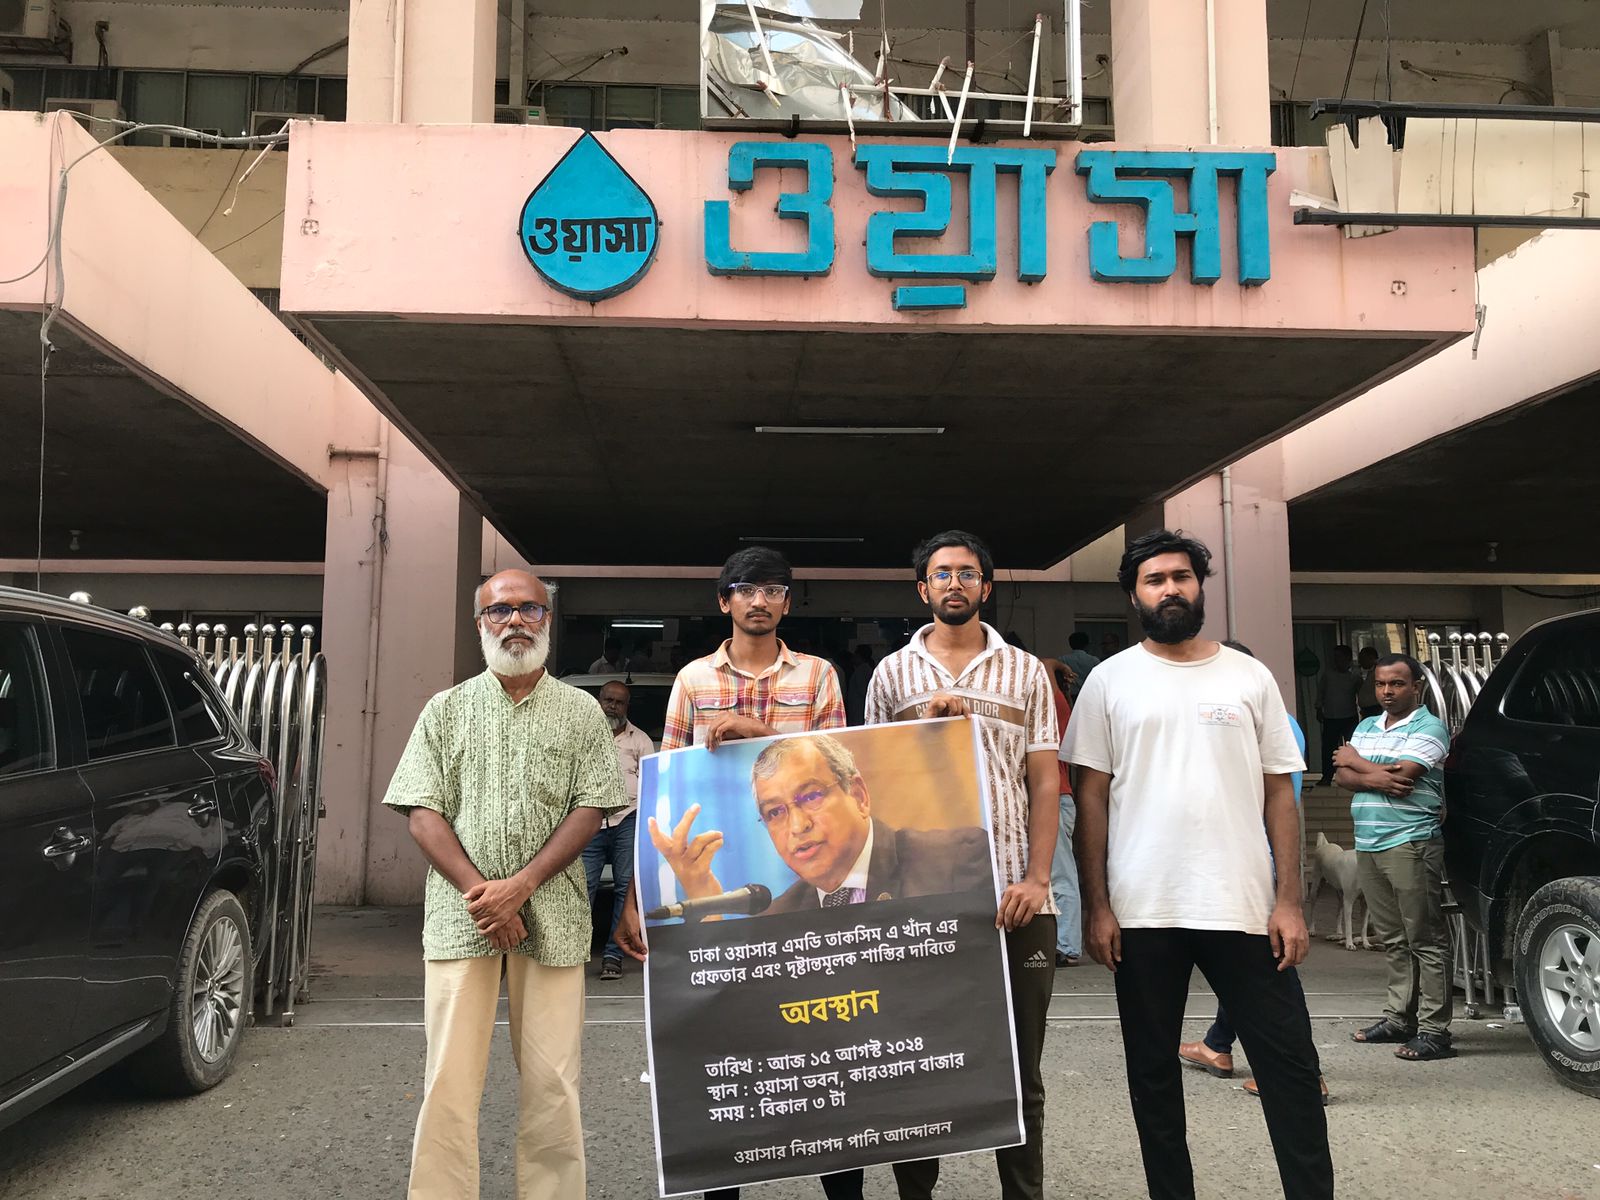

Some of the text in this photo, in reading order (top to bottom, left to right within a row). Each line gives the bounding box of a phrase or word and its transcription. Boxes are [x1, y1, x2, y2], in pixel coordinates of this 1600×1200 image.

[529, 216, 651, 261] ওয়াসা
[704, 141, 1276, 310] ওয়াসা
[973, 699, 1000, 718] DIOR
[688, 947, 720, 964] ঢাকা
[724, 941, 777, 961] ওয়াসার
[782, 932, 821, 953] এমডি
[824, 926, 882, 947] তাকসিম
[886, 926, 899, 940] এ
[936, 919, 959, 935] এর
[691, 939, 957, 985] গ্রেফতার এবং দৃষ্টান্তমূলক শাস্তির দাবিতে
[779, 989, 880, 1025] অবস্থান
[705, 1056, 753, 1078] তারিখ
[767, 1054, 806, 1070] আজ
[811, 1051, 831, 1067] ১৫
[834, 1039, 882, 1061] আগস্ট
[886, 1037, 924, 1054] ২০২৪
[707, 1083, 739, 1102] স্থান
[754, 1076, 799, 1096] ওয়াসা
[802, 1071, 844, 1091] ভবন,
[848, 1060, 915, 1082] কারওয়ান
[919, 1052, 965, 1072] বাজার
[1551, 1051, 1600, 1072] UNLOP
[709, 1105, 744, 1122] সময়
[758, 1096, 807, 1117] বিকাল
[813, 1098, 826, 1109] ৩
[829, 1089, 847, 1106] টা
[734, 1121, 952, 1163] ওয়াসার নিরাপদ পানি আন্দোলন
